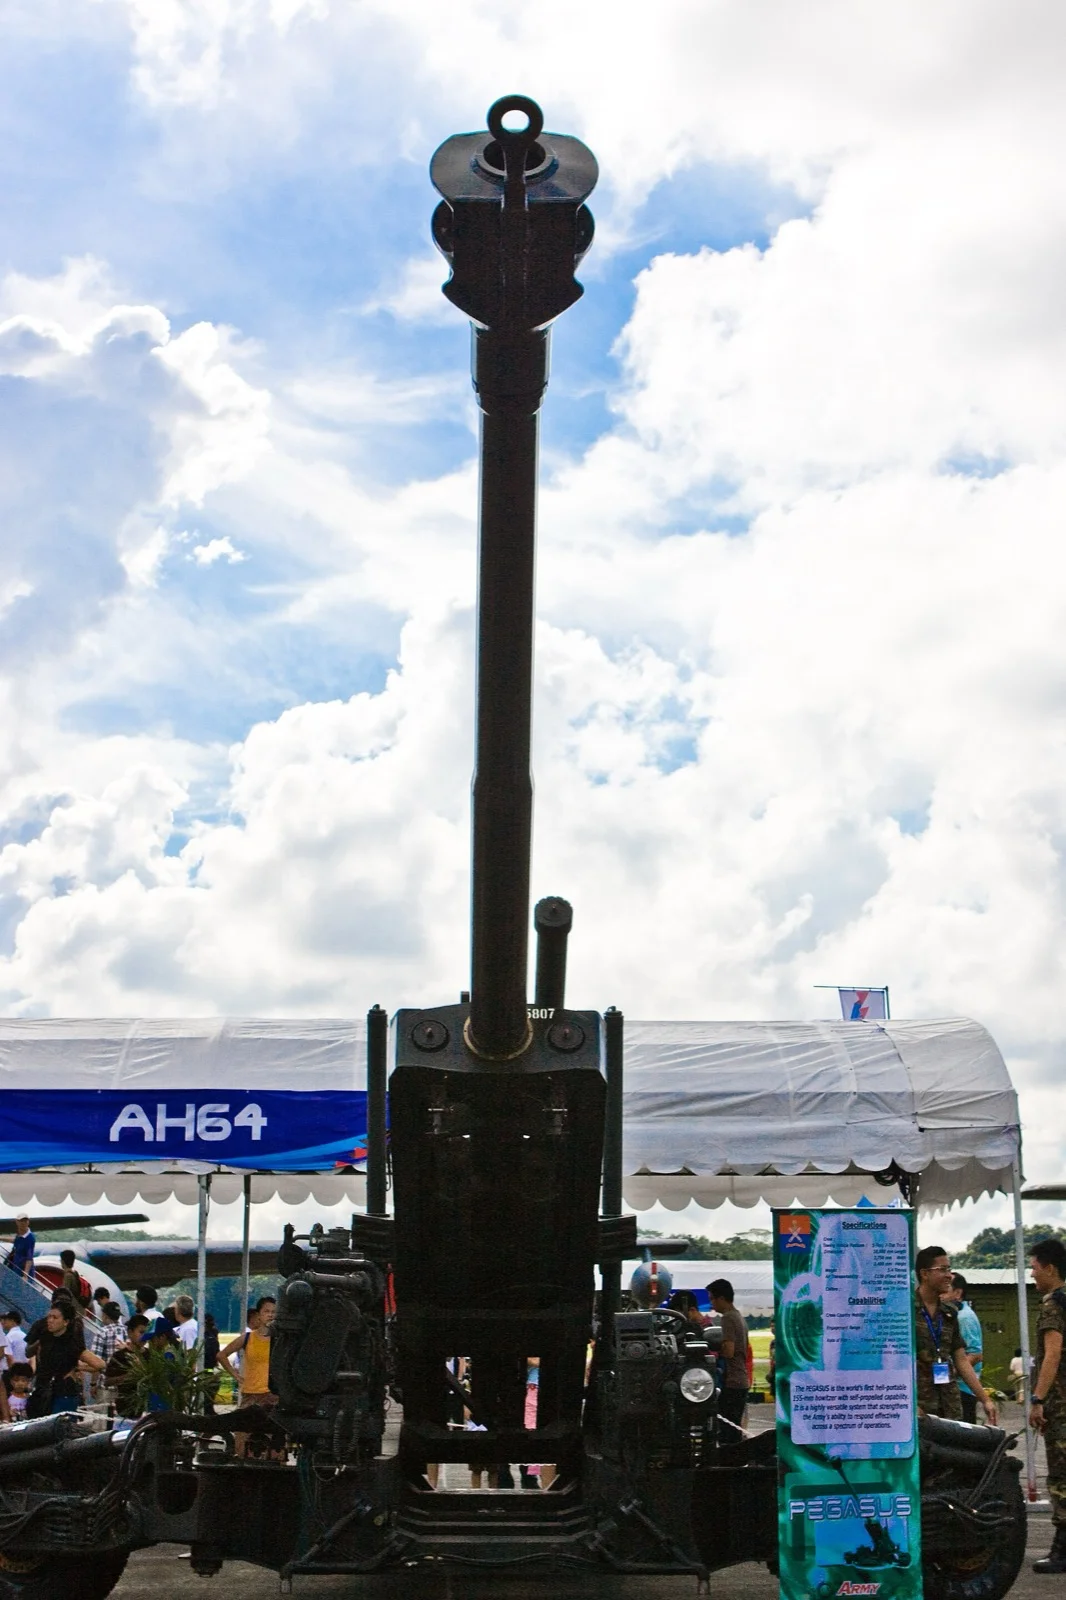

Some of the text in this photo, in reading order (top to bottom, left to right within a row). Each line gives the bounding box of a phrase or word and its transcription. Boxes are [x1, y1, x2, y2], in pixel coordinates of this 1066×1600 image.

[109, 1103, 268, 1142] AH64
[842, 1222, 887, 1230] Specifications
[848, 1297, 886, 1305] Capabilities
[788, 1495, 912, 1520] PEGASUS
